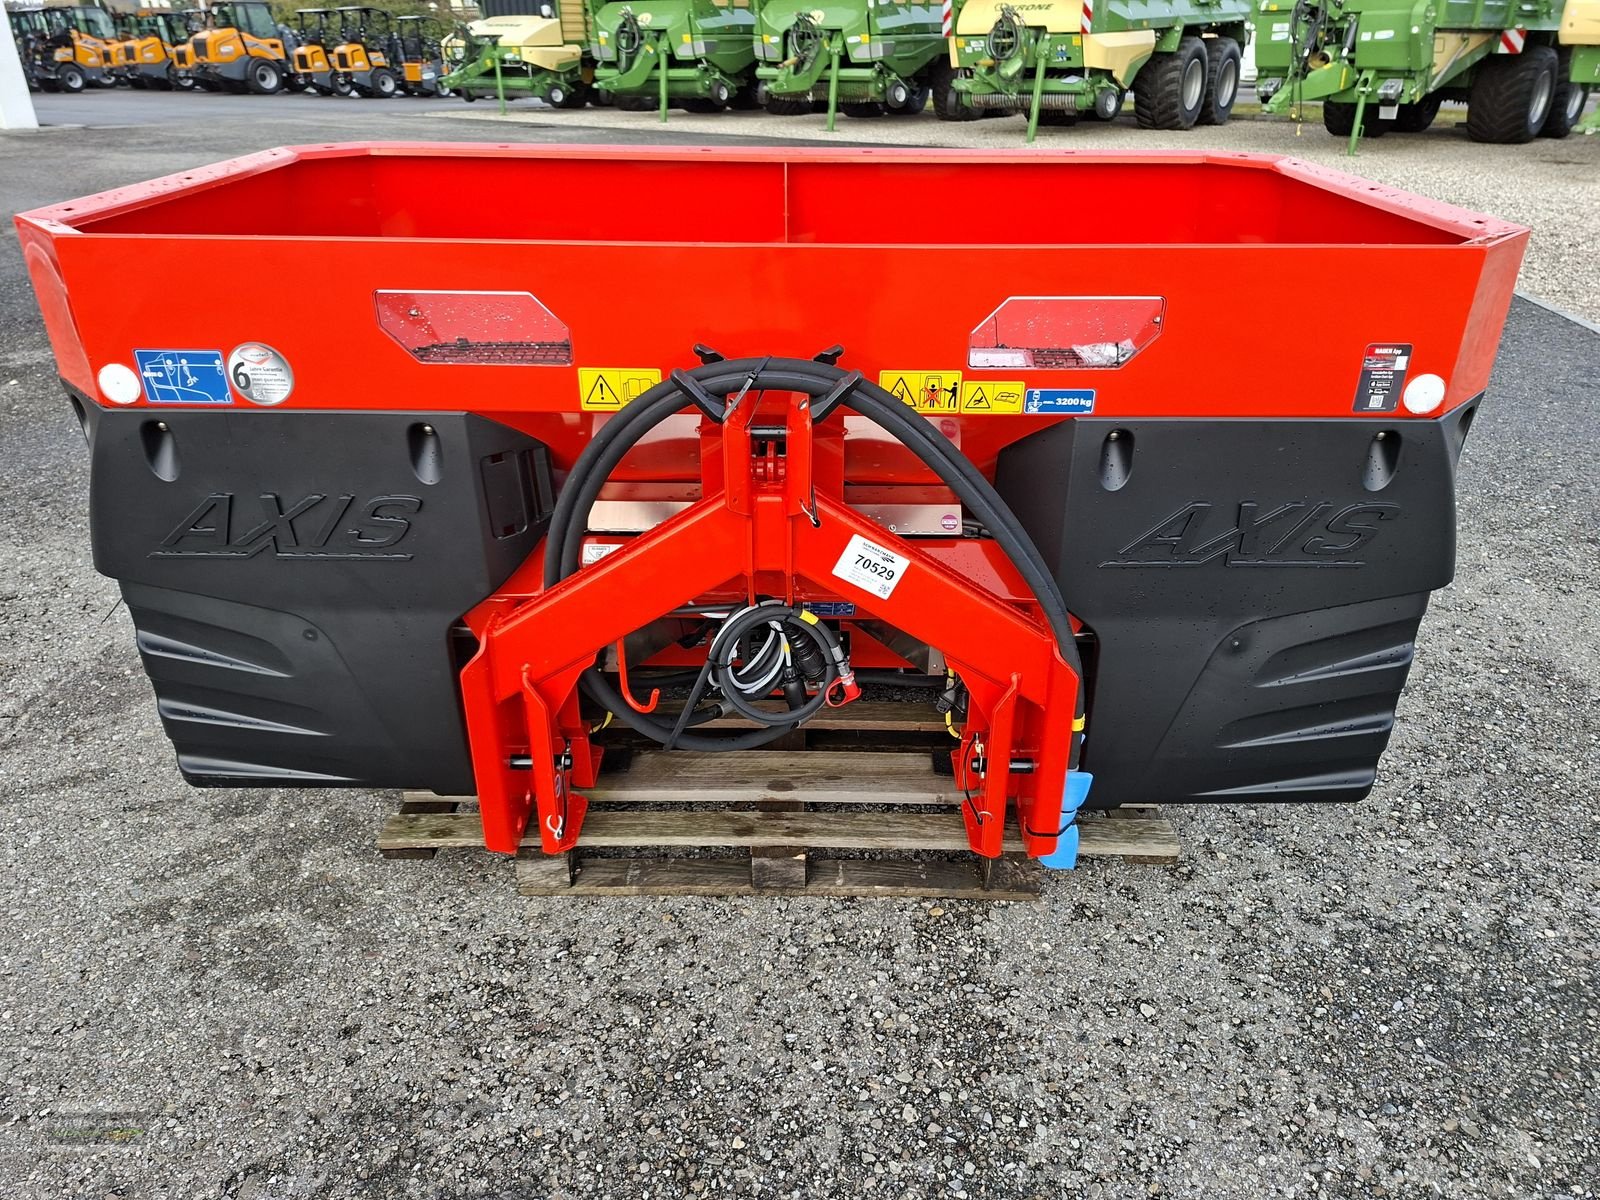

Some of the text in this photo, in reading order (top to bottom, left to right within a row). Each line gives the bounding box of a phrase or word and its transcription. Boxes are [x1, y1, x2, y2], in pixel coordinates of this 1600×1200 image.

[233, 362, 251, 390] 6
[1055, 397, 1080, 406] 3200
[1080, 398, 1092, 408] kg
[160, 492, 423, 547] AXIS
[1117, 500, 1401, 556] AXIS
[855, 554, 895, 580] 70529
